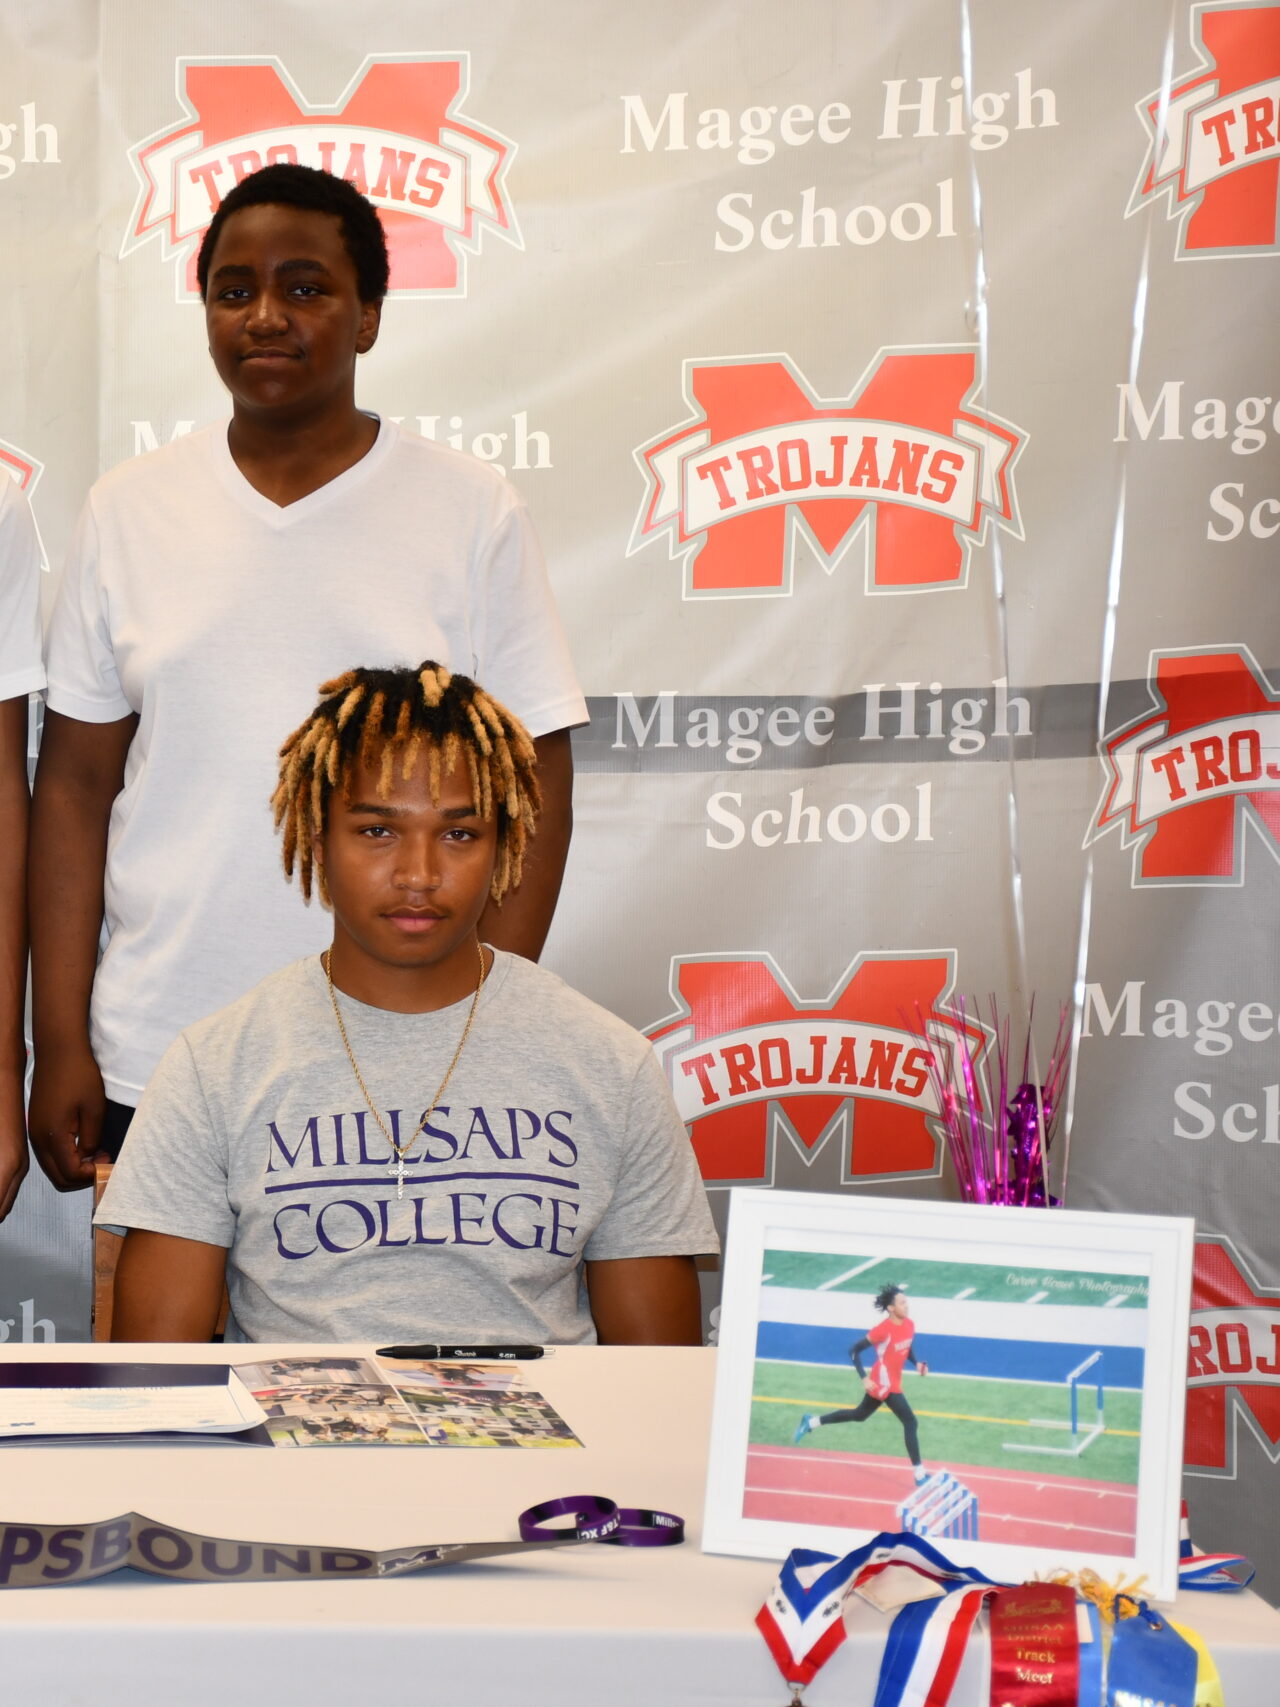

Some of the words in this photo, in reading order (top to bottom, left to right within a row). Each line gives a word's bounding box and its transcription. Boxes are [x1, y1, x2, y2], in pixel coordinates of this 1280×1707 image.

[619, 91, 851, 165] Magee
[877, 67, 1060, 151] High
[714, 178, 958, 253] School
[1113, 381, 1280, 455] Mag
[695, 435, 965, 511] TROJANS
[611, 690, 835, 764] Magee
[859, 676, 1033, 755] High
[705, 781, 935, 850] School
[1080, 981, 1280, 1056] Mage
[681, 1035, 935, 1106] TROJANS
[264, 1106, 578, 1173] MILLSAPS
[273, 1193, 580, 1260] COLLEGE
[1016, 1647, 1056, 1664] Track
